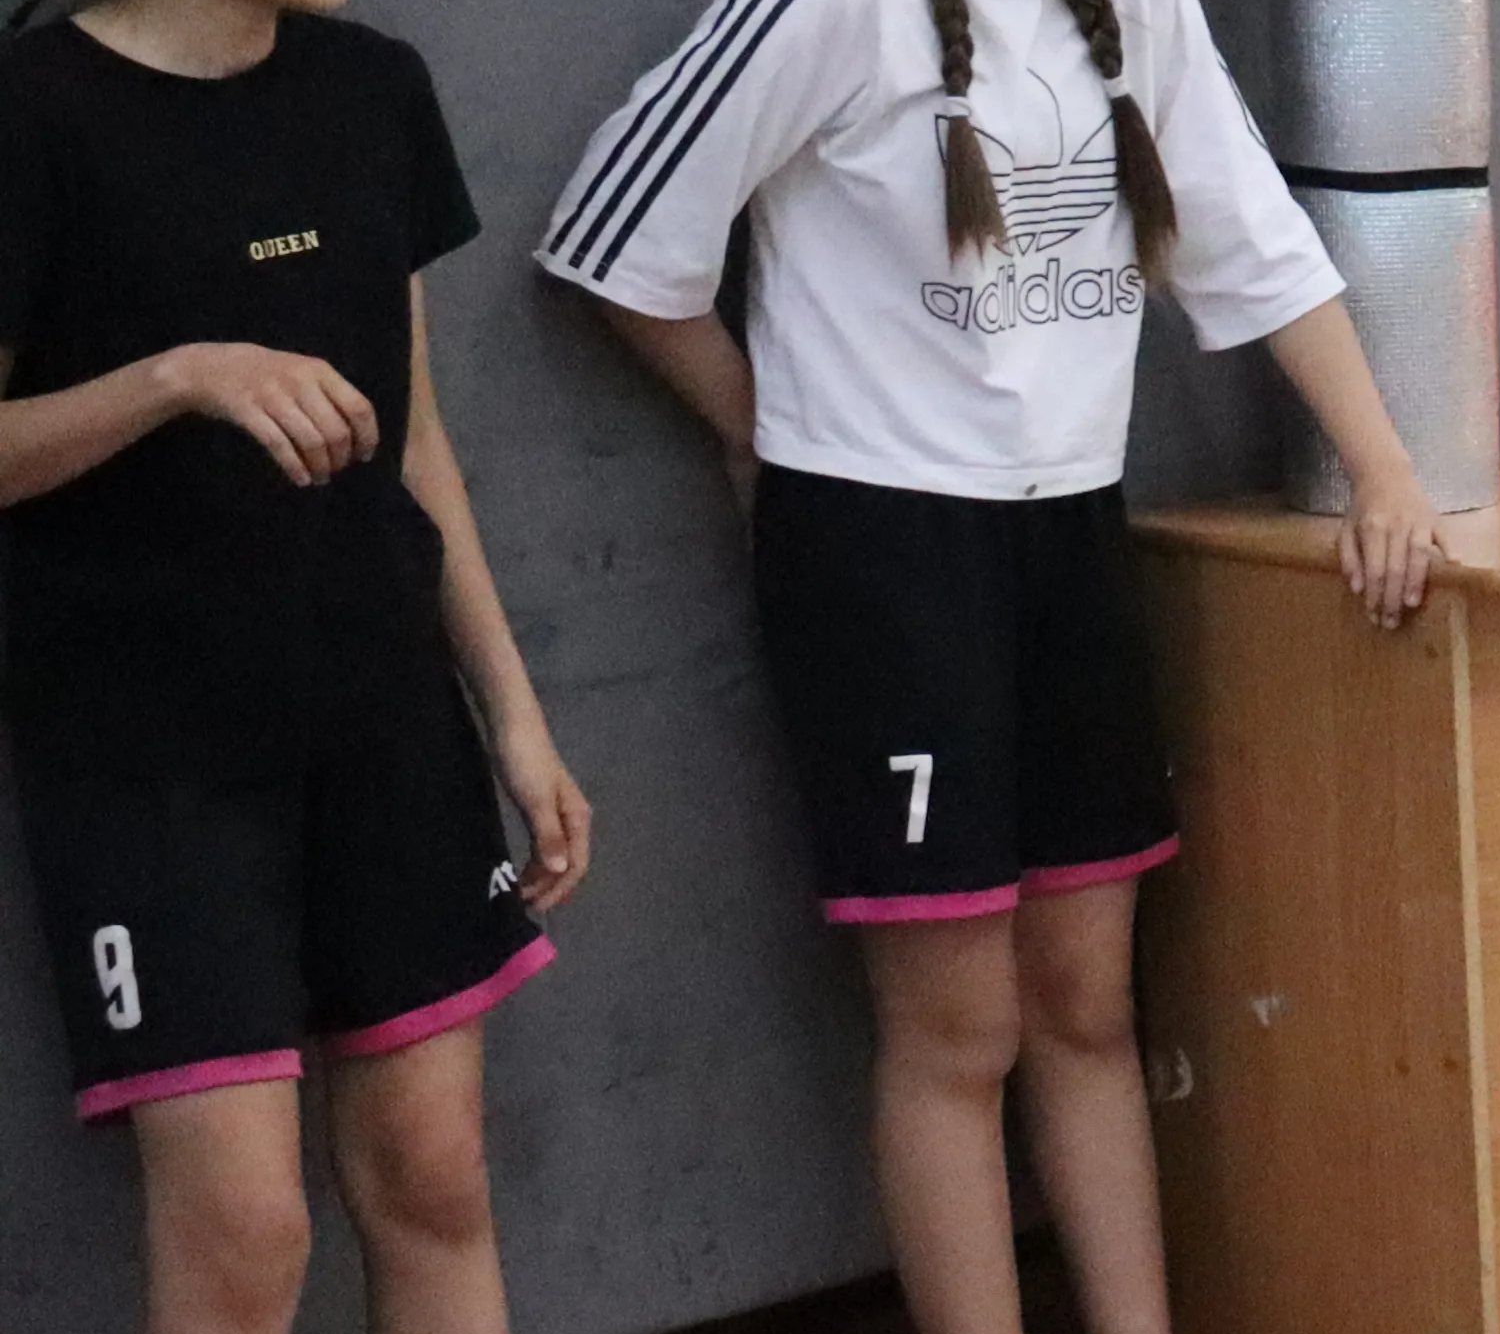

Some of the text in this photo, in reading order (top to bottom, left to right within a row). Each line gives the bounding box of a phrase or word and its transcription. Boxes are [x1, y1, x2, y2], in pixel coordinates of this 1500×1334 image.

[249, 230, 320, 261] QUEEN
[921, 258, 1145, 335] adidas
[888, 754, 933, 843] 7
[94, 924, 142, 1030] 9
